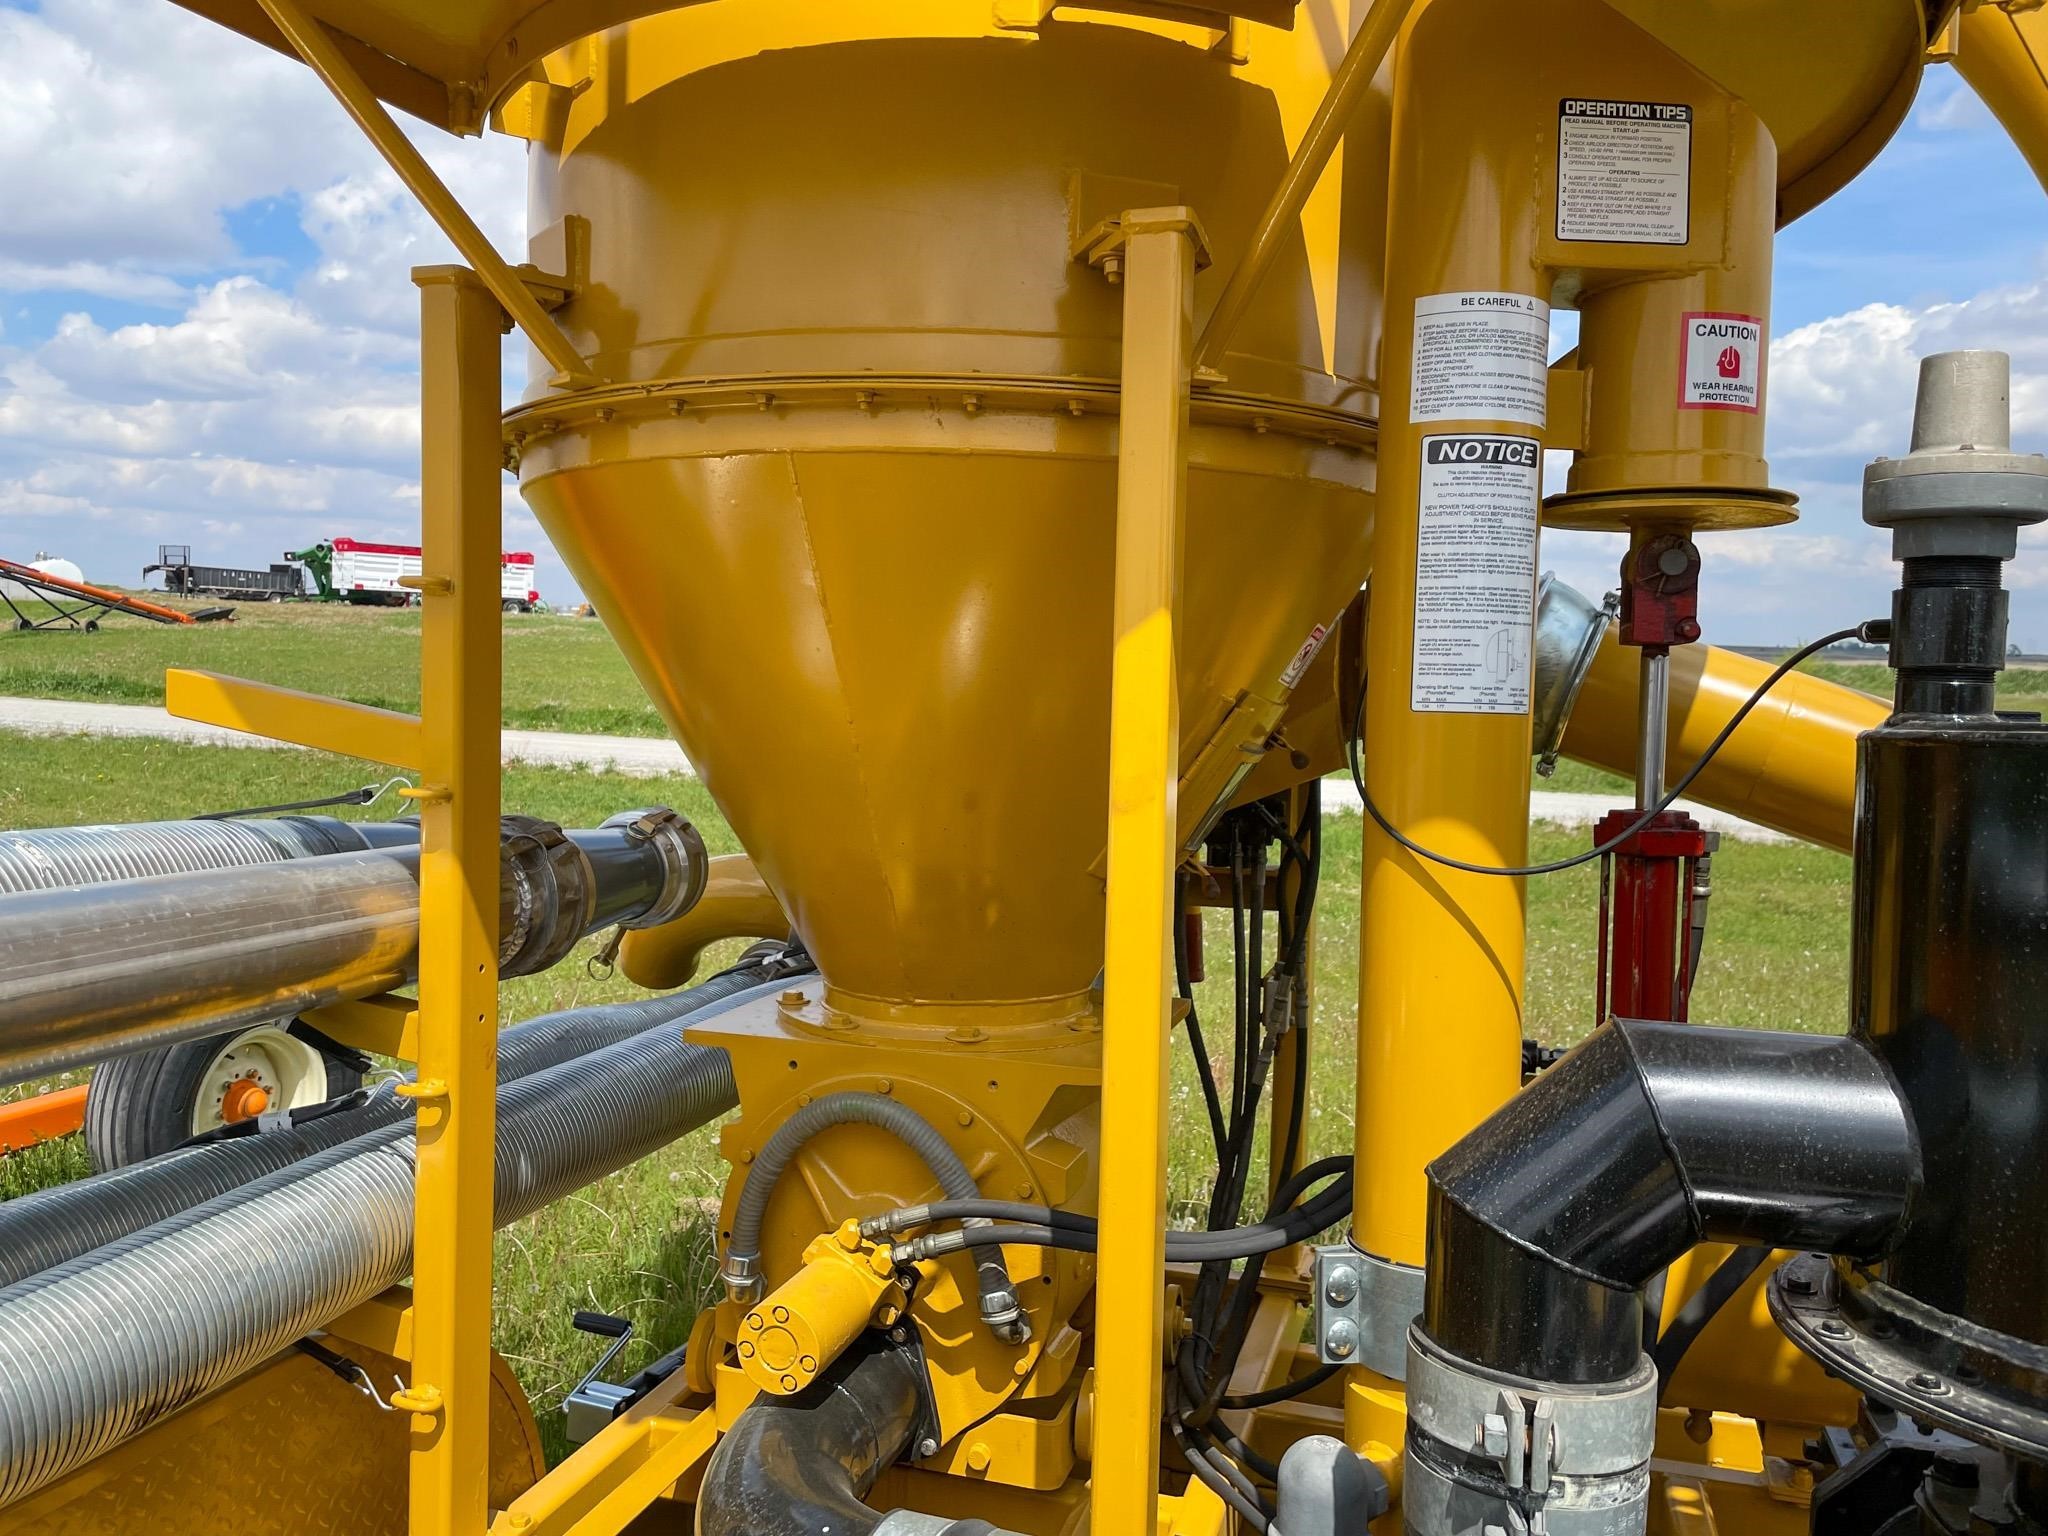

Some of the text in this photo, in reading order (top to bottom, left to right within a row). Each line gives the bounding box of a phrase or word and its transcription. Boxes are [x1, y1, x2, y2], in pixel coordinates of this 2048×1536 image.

[1565, 101, 1686, 119] OPERATION TIPS
[1461, 297, 1521, 308] BE CAREFUL
[1695, 324, 1757, 342] CAUTION
[1722, 383, 1754, 394] HEARING
[1699, 393, 1749, 403] PROTECTION
[1438, 441, 1534, 464] NOTICE
